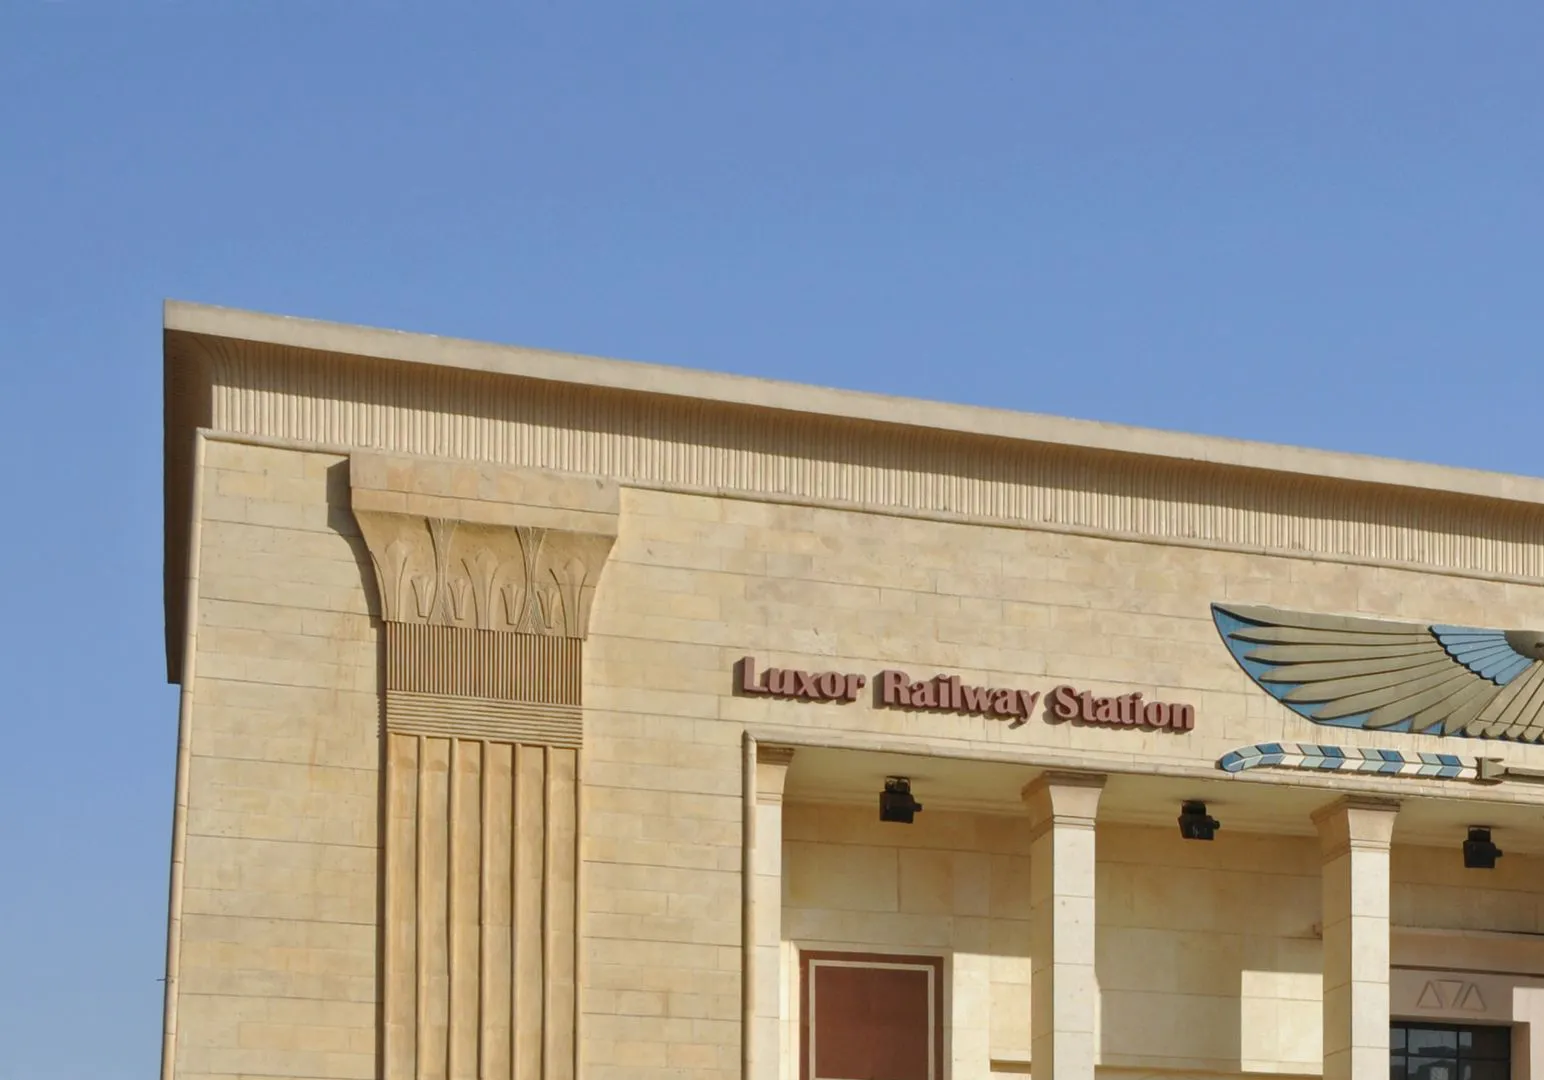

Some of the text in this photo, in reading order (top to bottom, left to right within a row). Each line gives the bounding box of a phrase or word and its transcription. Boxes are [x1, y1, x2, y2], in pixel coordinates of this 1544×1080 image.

[735, 656, 1195, 733] Luxor Railway Station
